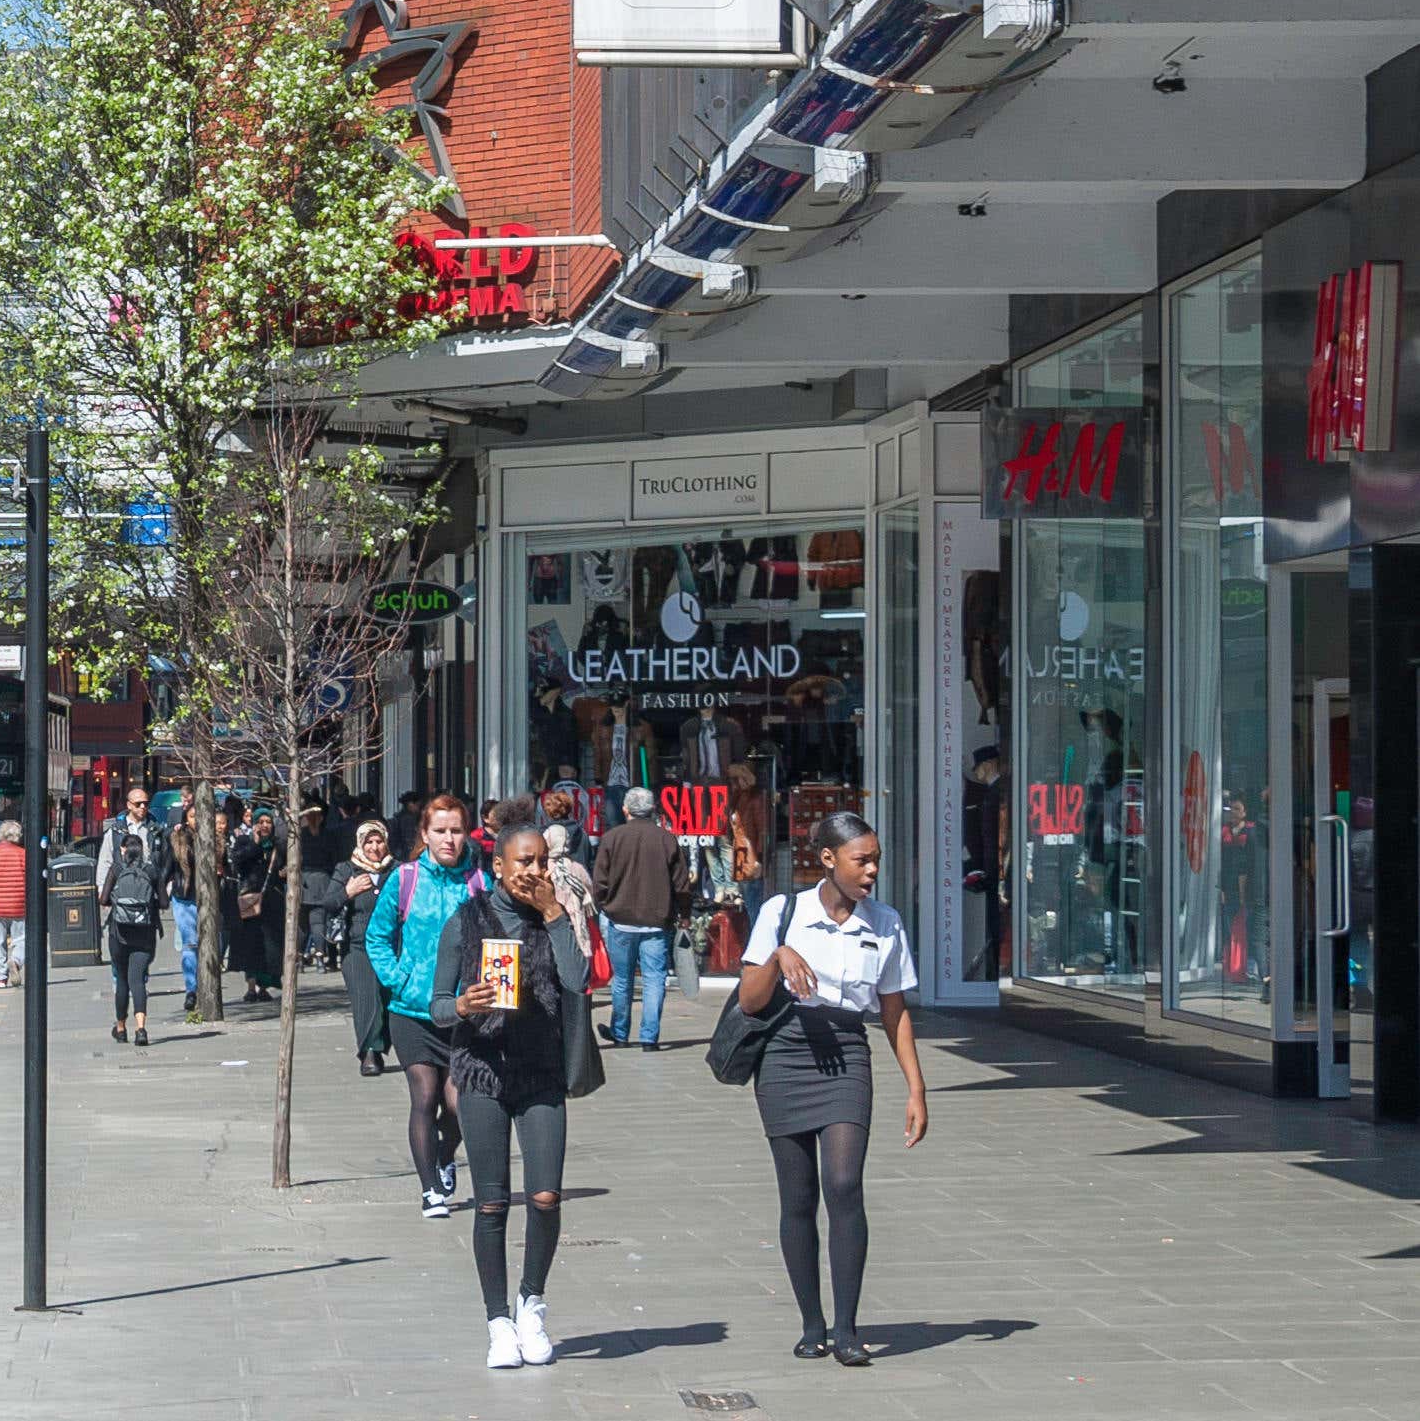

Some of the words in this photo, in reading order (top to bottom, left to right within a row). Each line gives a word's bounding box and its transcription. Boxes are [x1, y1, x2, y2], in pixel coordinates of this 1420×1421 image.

[1002, 420, 1127, 504] H&M
[373, 591, 448, 612] schuh
[567, 644, 800, 682] LEATHERLAND
[642, 692, 730, 709] FASHION
[661, 785, 728, 837] SALE
